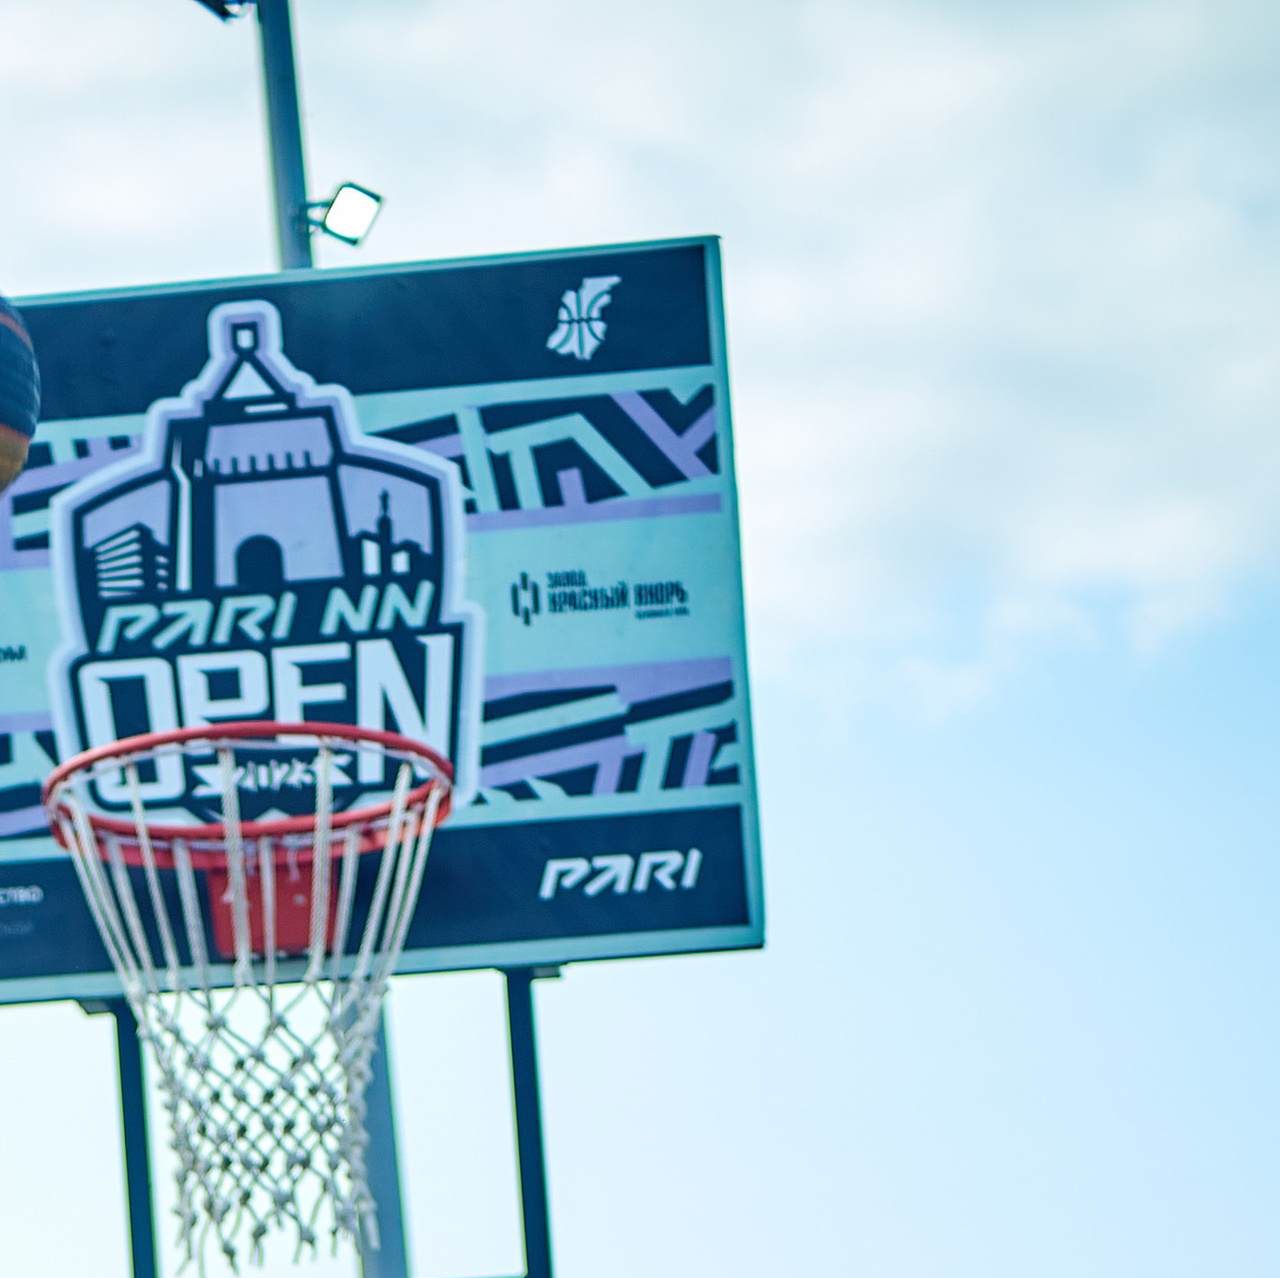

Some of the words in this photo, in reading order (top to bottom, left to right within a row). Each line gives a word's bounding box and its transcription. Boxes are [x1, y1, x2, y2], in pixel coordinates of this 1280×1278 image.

[97, 592, 298, 654] PARI
[321, 582, 434, 636] NN
[78, 634, 455, 801] OPEN
[539, 848, 702, 900] PARI
